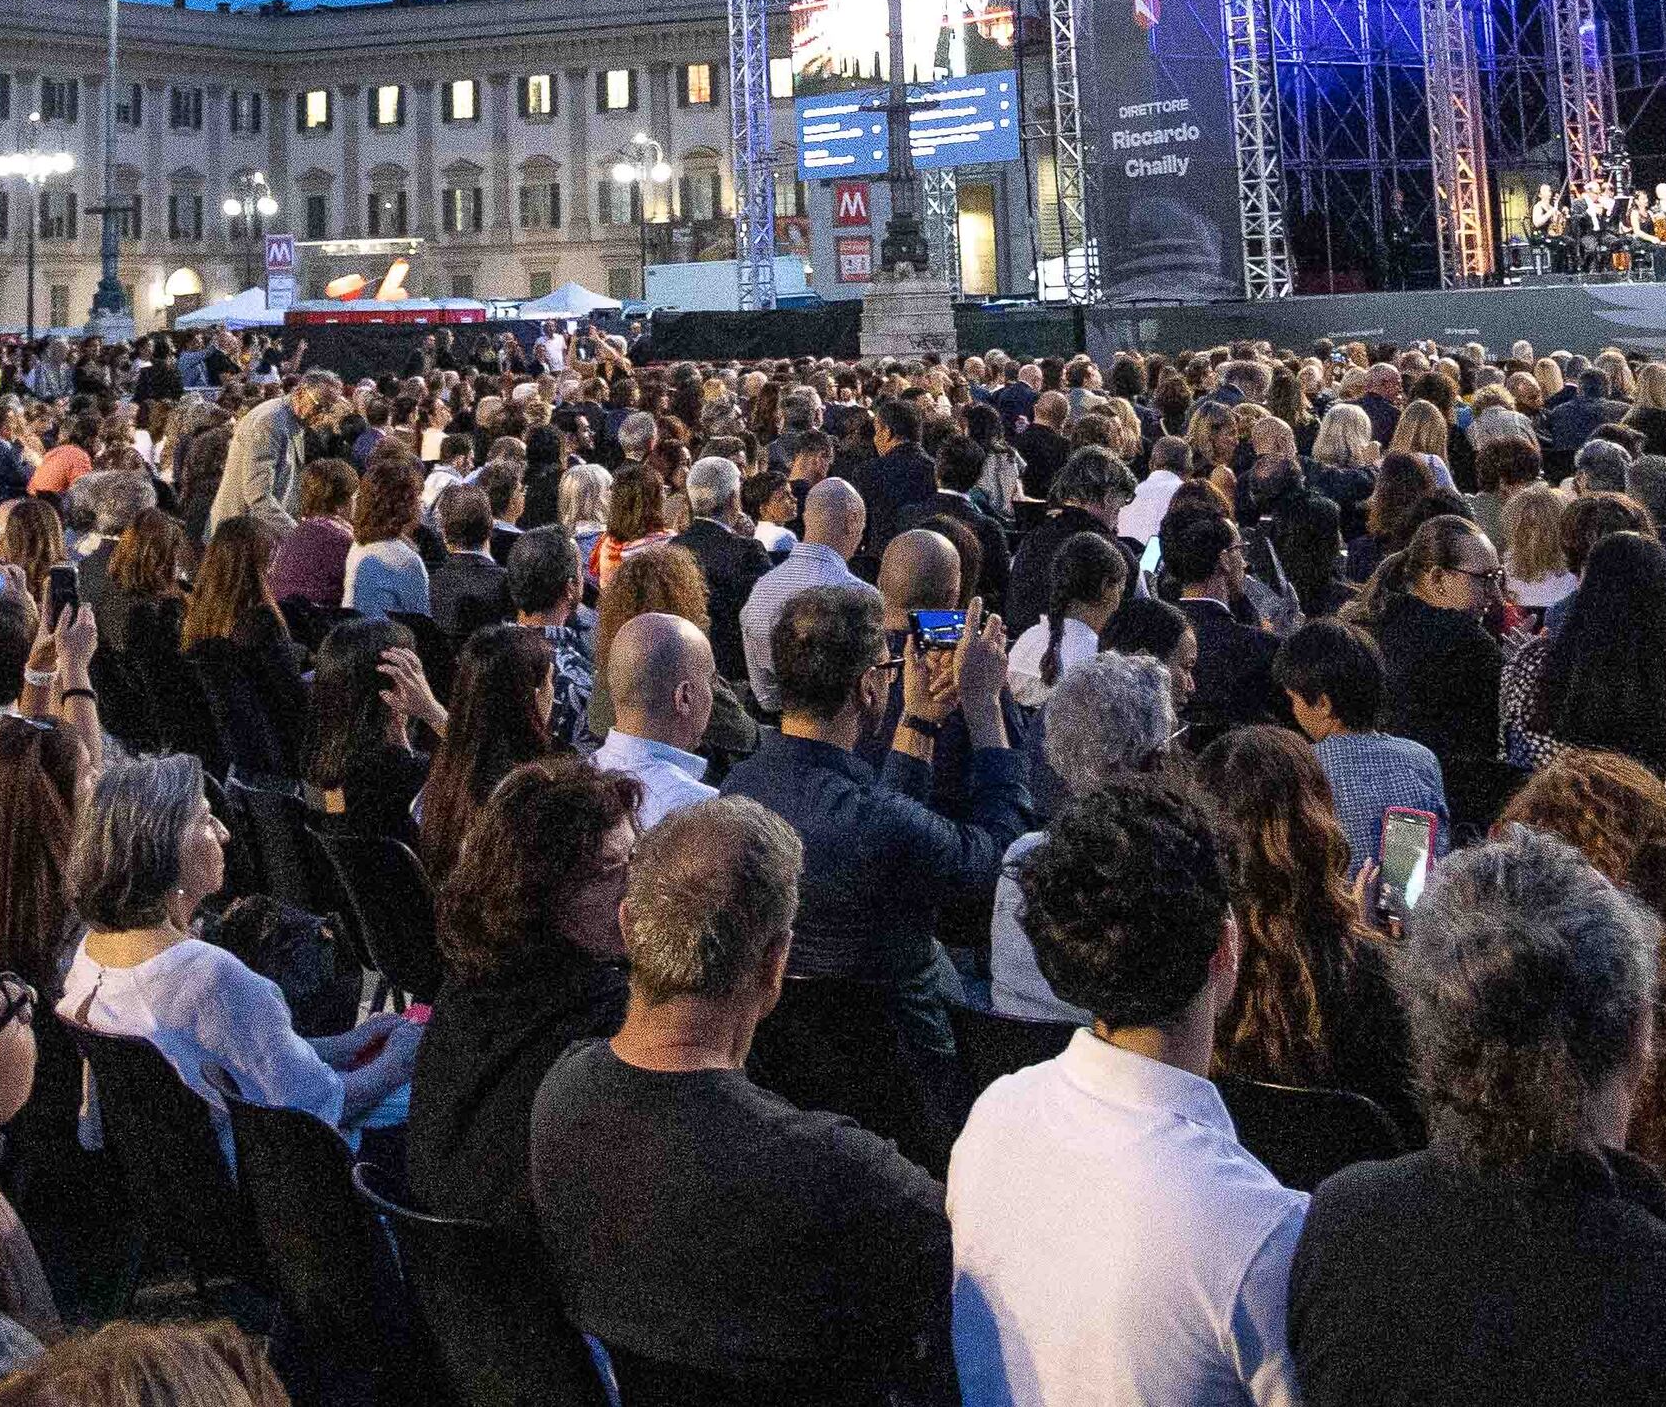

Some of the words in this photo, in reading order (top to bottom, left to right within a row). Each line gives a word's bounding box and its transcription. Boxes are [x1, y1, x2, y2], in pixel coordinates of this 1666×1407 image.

[1118, 98, 1190, 119] DIRETTORE
[1112, 122, 1200, 150] Riccardo
[1124, 154, 1190, 177] Chailly
[839, 191, 867, 218] M
[268, 242, 291, 263] M
